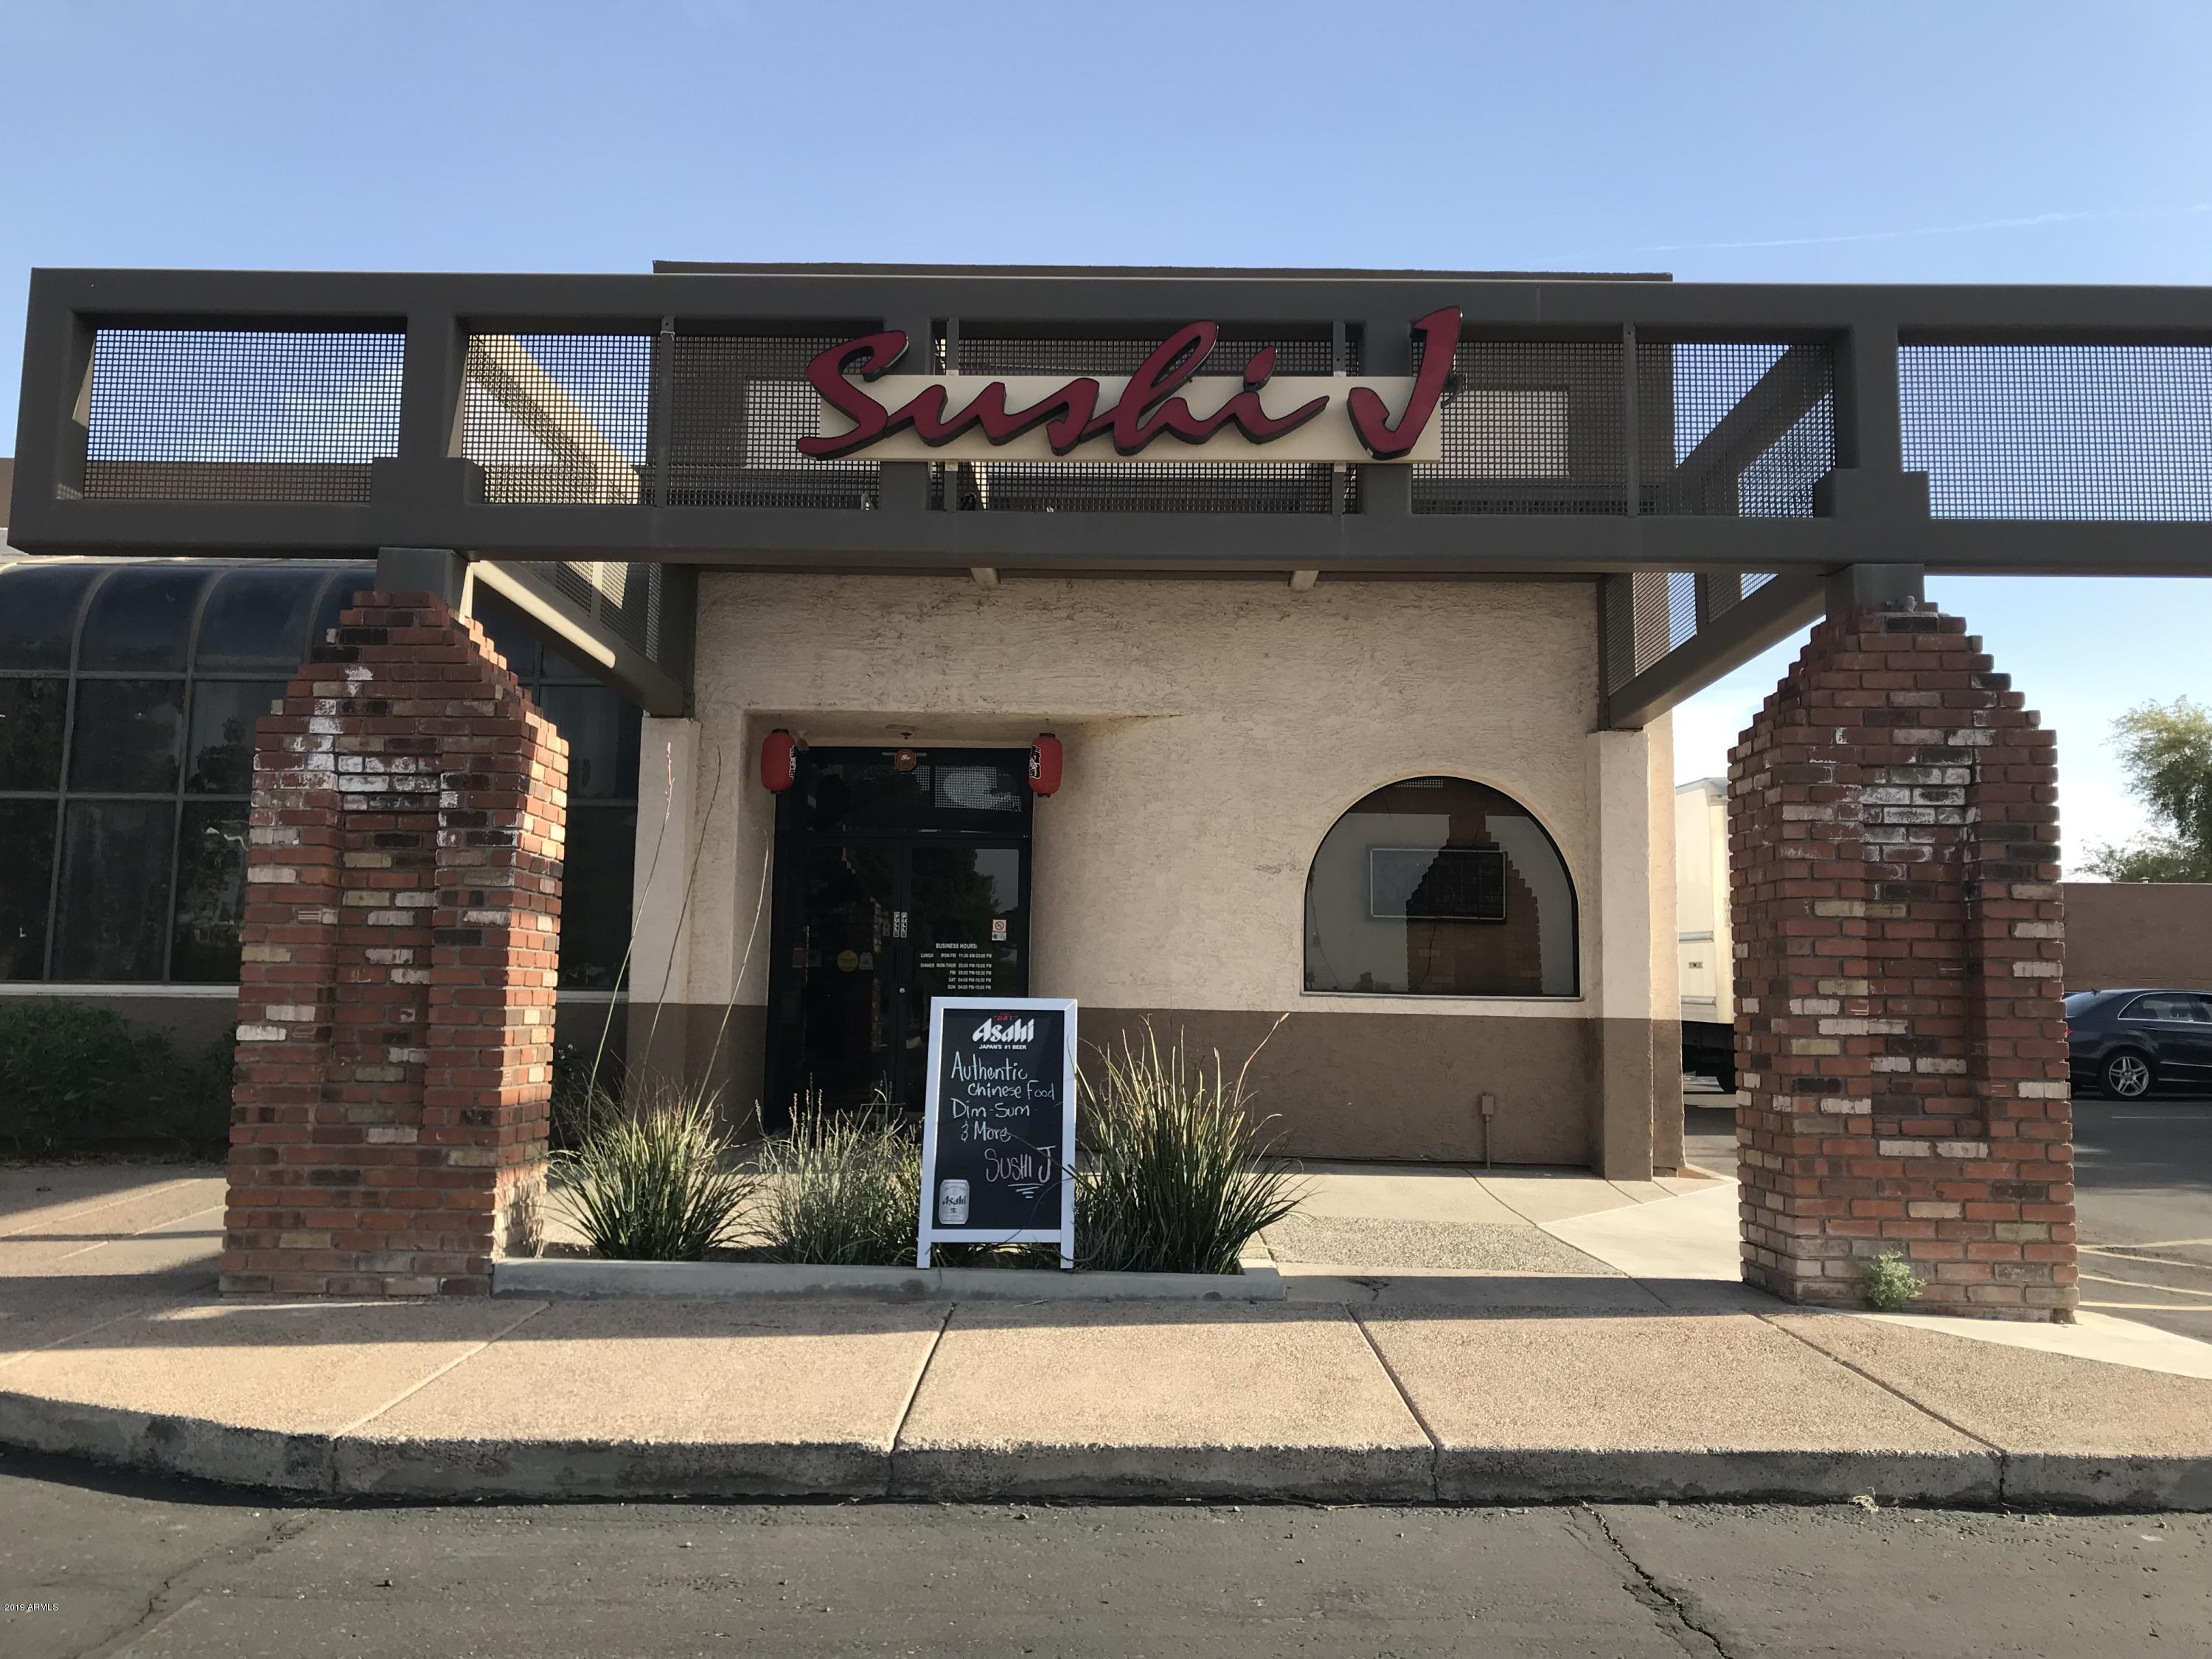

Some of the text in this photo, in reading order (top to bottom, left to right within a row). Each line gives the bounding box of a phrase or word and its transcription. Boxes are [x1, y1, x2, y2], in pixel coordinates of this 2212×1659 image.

[797, 305, 1463, 460] Sushi J
[972, 1018, 1034, 1043] Asahi
[950, 1051, 1028, 1082] Authentic
[1027, 1080, 1054, 1100] Food
[974, 1121, 1011, 1142] More
[984, 1145, 1056, 1183] SUSHI J
[942, 1195, 966, 1206] Asahi
